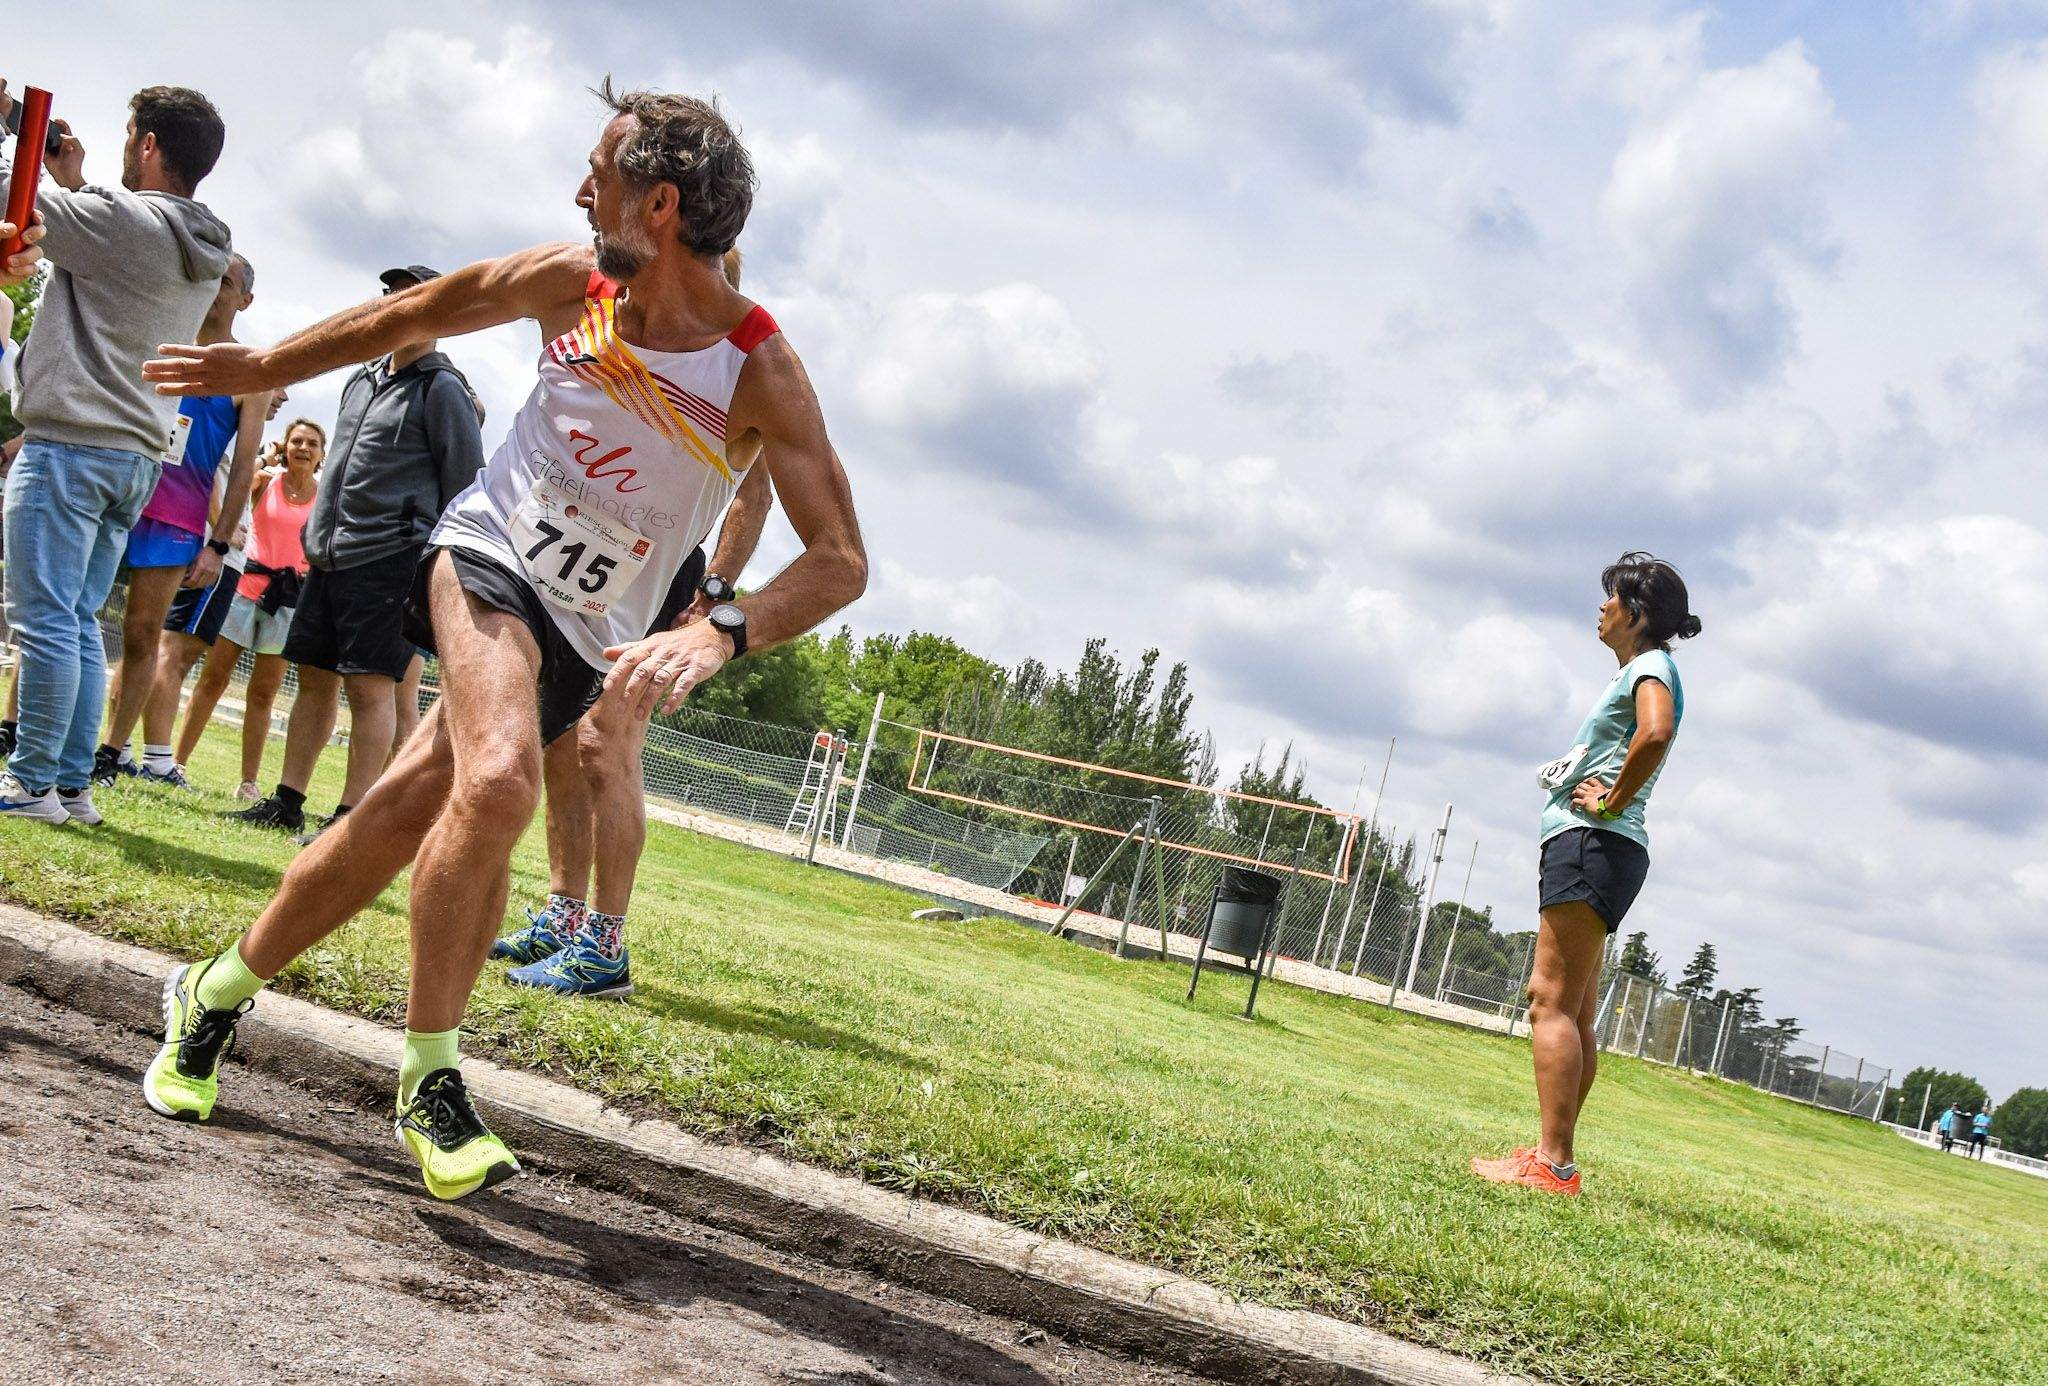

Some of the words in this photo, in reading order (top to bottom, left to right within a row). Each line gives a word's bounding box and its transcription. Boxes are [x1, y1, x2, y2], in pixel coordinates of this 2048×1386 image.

[530, 449, 680, 529] rafaelhoteles
[525, 518, 618, 594] 715
[548, 584, 575, 604] rasán
[582, 598, 608, 614] 2023
